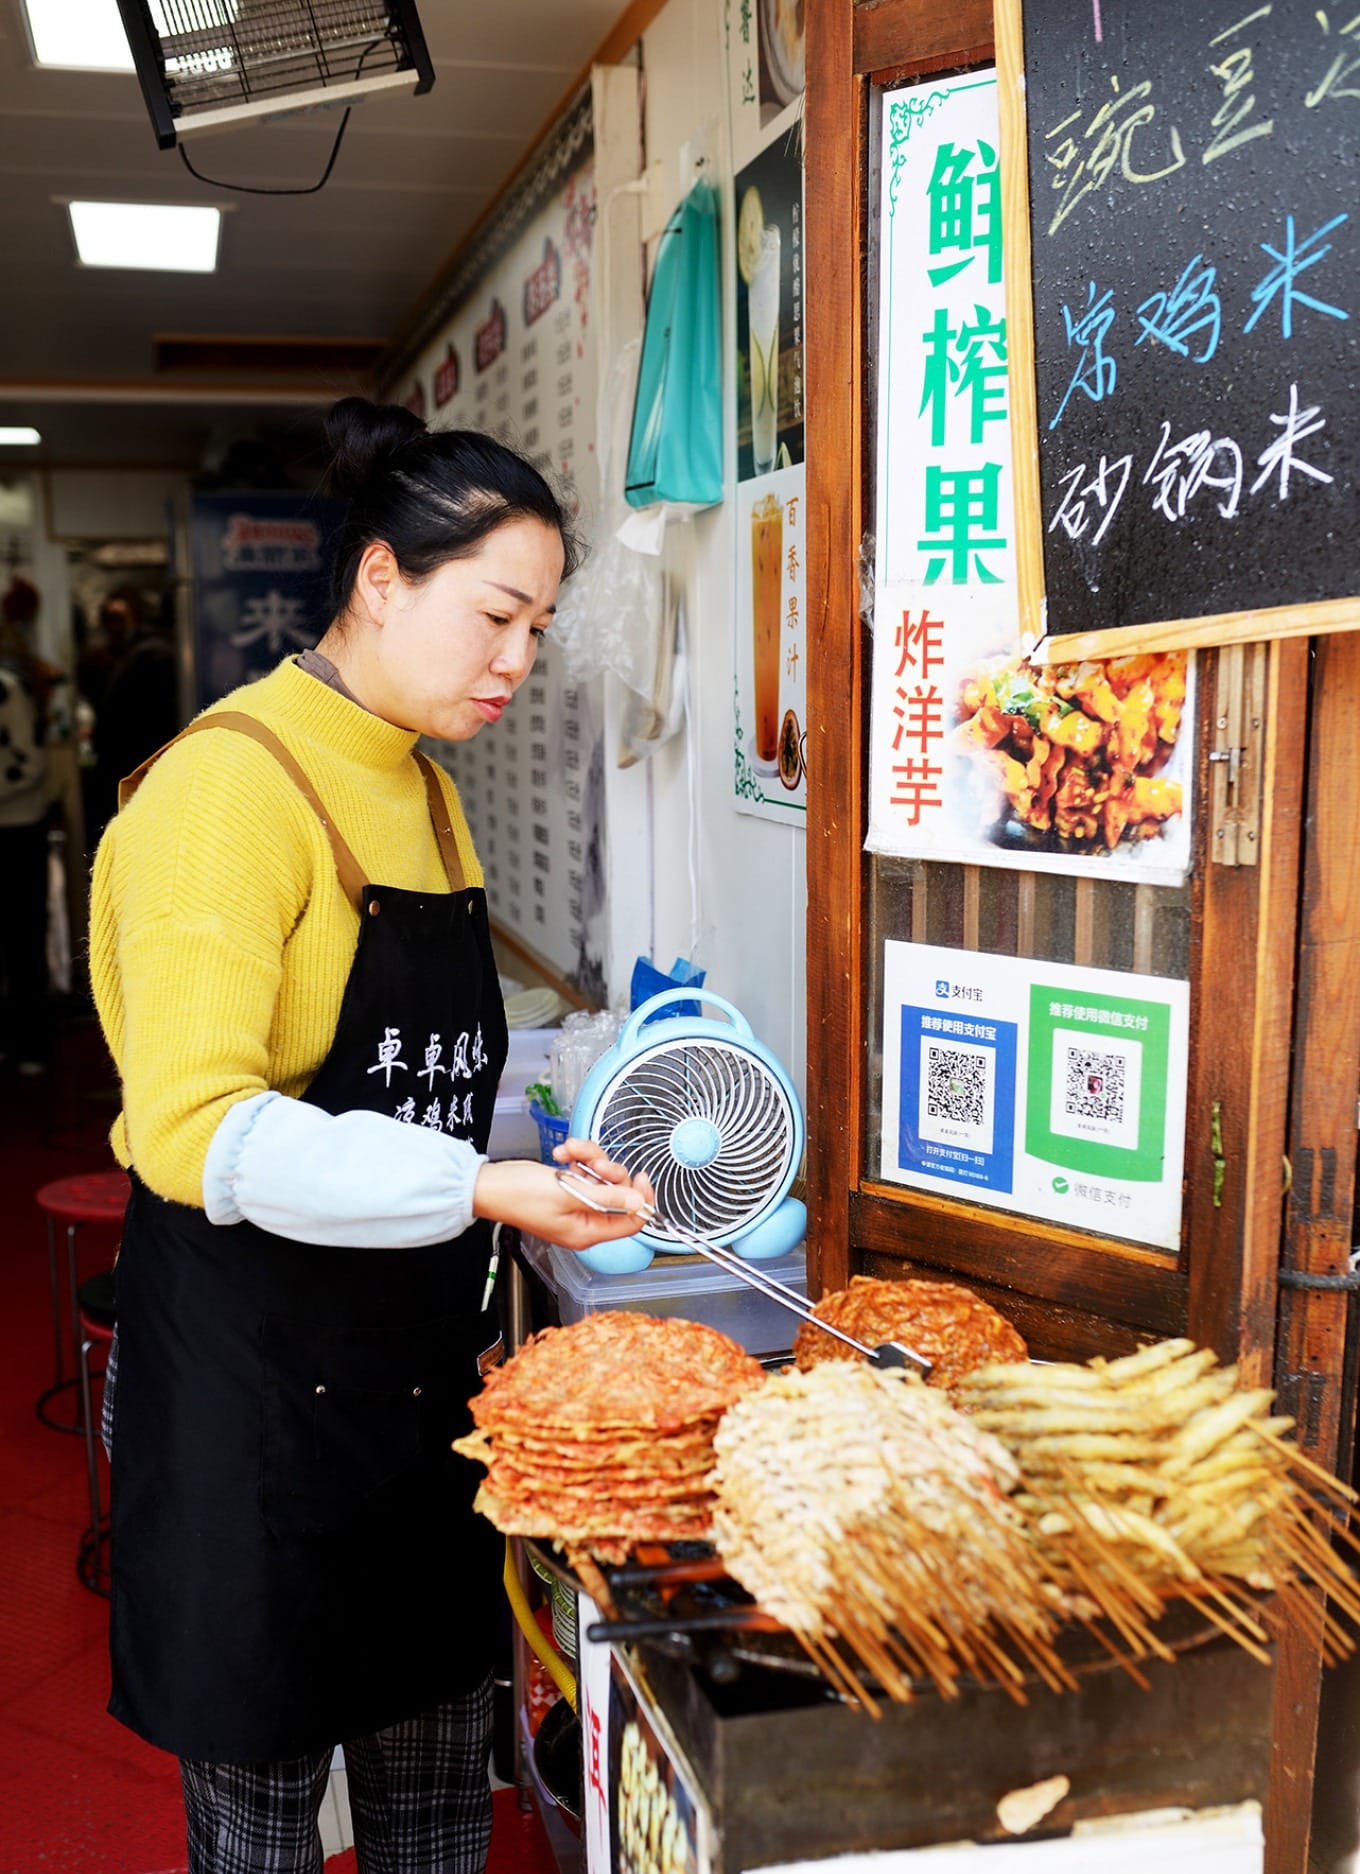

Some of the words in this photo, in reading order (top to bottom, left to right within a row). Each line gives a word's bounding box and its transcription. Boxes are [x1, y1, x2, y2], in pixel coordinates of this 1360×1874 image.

[917, 139, 1007, 586] 鲜榨果
[1048, 384, 1333, 546] 砂锅米
[785, 496, 800, 684] 百香果汁
[890, 609, 946, 827] 炸洋芋
[921, 1014, 997, 1041] 推荐使用支付宝
[951, 984, 984, 1002] 支付宝
[1048, 1001, 1150, 1031] 推荐使用微信支付
[366, 1021, 488, 1092] 卓卓风味
[1074, 1182, 1132, 1209] 微信支付
